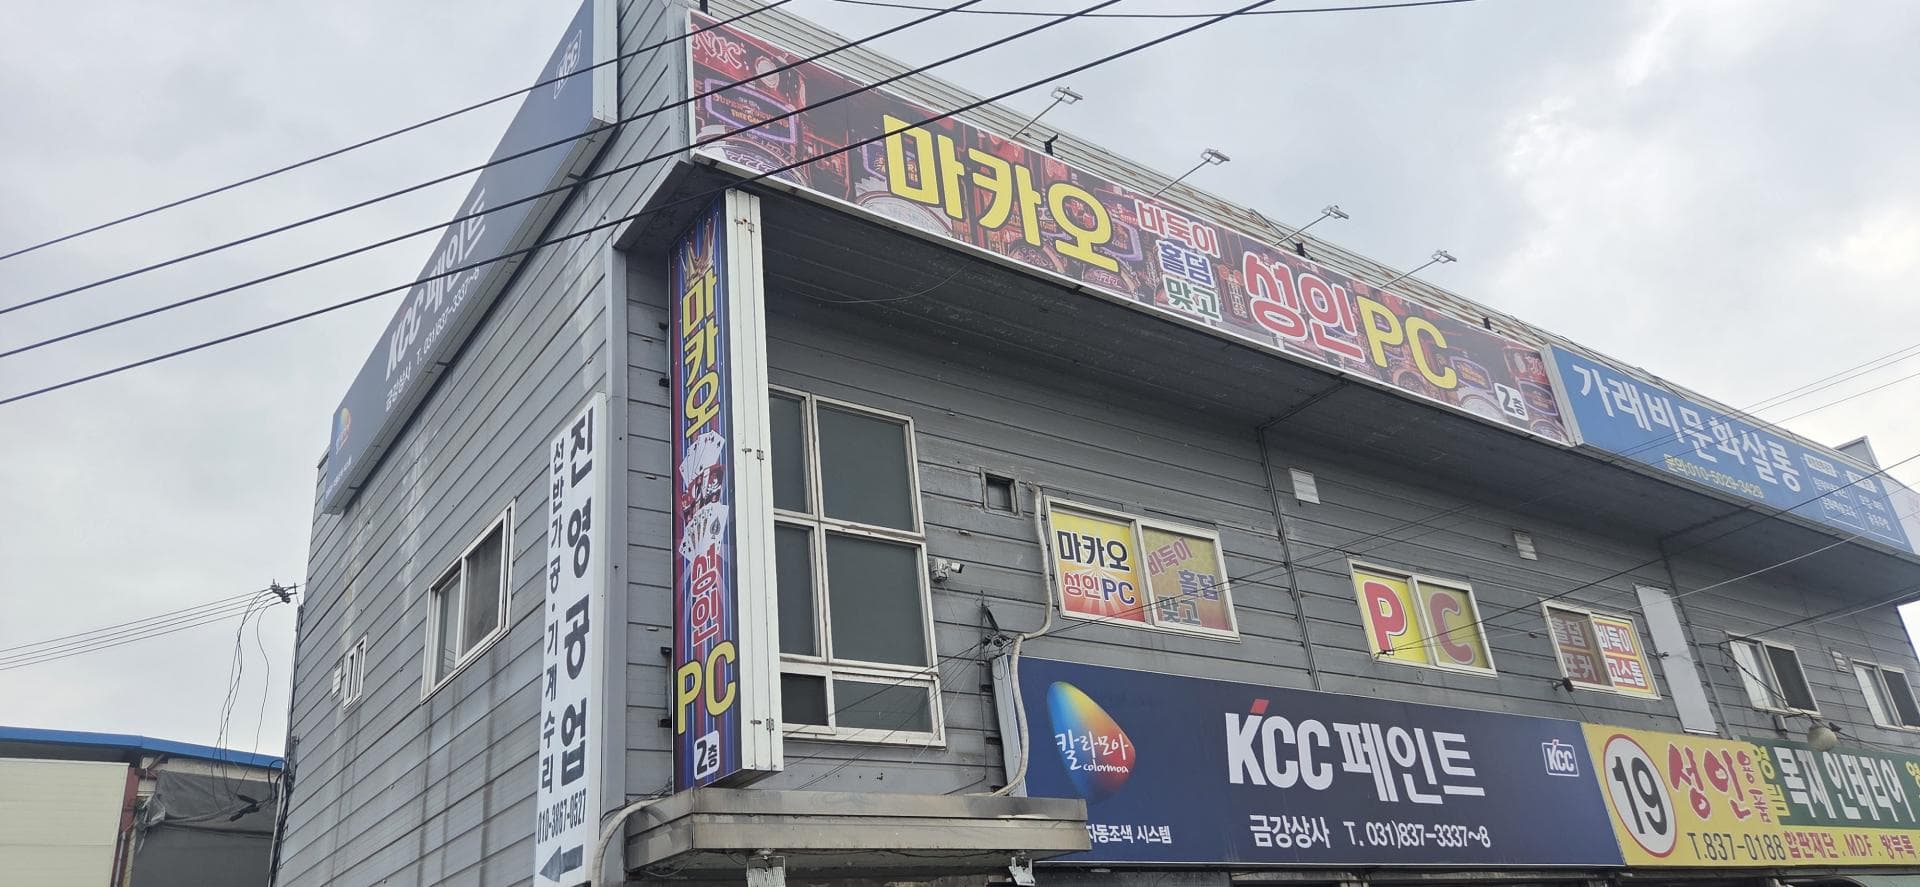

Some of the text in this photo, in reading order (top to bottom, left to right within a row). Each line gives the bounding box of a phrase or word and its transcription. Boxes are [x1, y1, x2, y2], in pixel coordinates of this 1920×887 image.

[883, 114, 1119, 273] 마카오
[1136, 200, 1220, 257] 바둑이
[1157, 241, 1214, 288] 홀덤
[1163, 275, 1222, 322] 맞고
[682, 267, 720, 438] 마카오
[1497, 385, 1526, 416] 2층
[1057, 531, 1130, 571] 마카오
[1148, 537, 1192, 576] 바둑이
[561, 407, 594, 786] 진영공업
[691, 543, 719, 647] 성인
[1179, 570, 1218, 600] 홀덤
[1158, 596, 1201, 624] 맞고
[1594, 623, 1634, 653] 바둑이
[677, 641, 736, 734] PC
[1605, 657, 1646, 687] 고스톱
[696, 738, 718, 775] 2층
[1550, 739, 1575, 772] KCC
[1612, 756, 1668, 836] 19
[1774, 747, 1838, 818] 목재
[1823, 751, 1916, 822] 인테리어
[1137, 825, 1172, 844] 시스템
[1250, 814, 1331, 848] 금강상사
